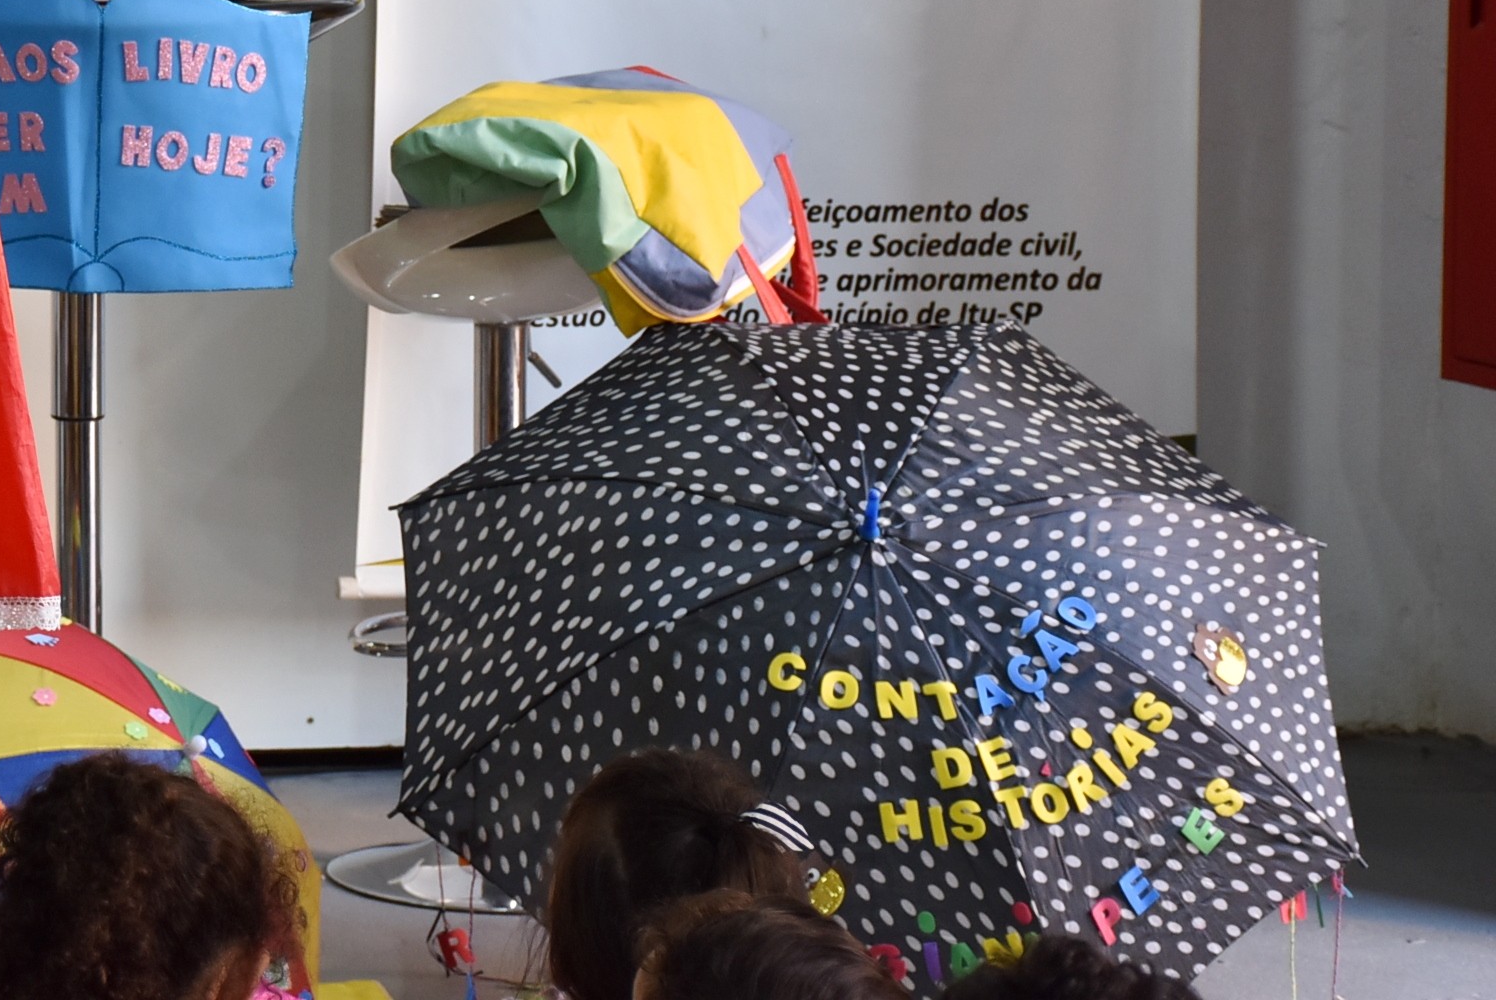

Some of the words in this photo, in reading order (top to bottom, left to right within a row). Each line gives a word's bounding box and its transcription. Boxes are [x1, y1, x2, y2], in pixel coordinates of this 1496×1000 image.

[122, 37, 267, 94] LIVRO
[120, 123, 287, 189] HOJE?
[979, 198, 1029, 223] dos
[845, 238, 862, 258] e
[870, 231, 1012, 258] Sociedade
[1019, 230, 1083, 261] civil,
[836, 267, 1058, 298] aprimoramento
[1066, 265, 1103, 292] da
[916, 300, 951, 326] de
[959, 301, 1044, 326] Itu-SP
[767, 595, 1098, 722] CONTAÇÃO
[930, 736, 1018, 791] DE
